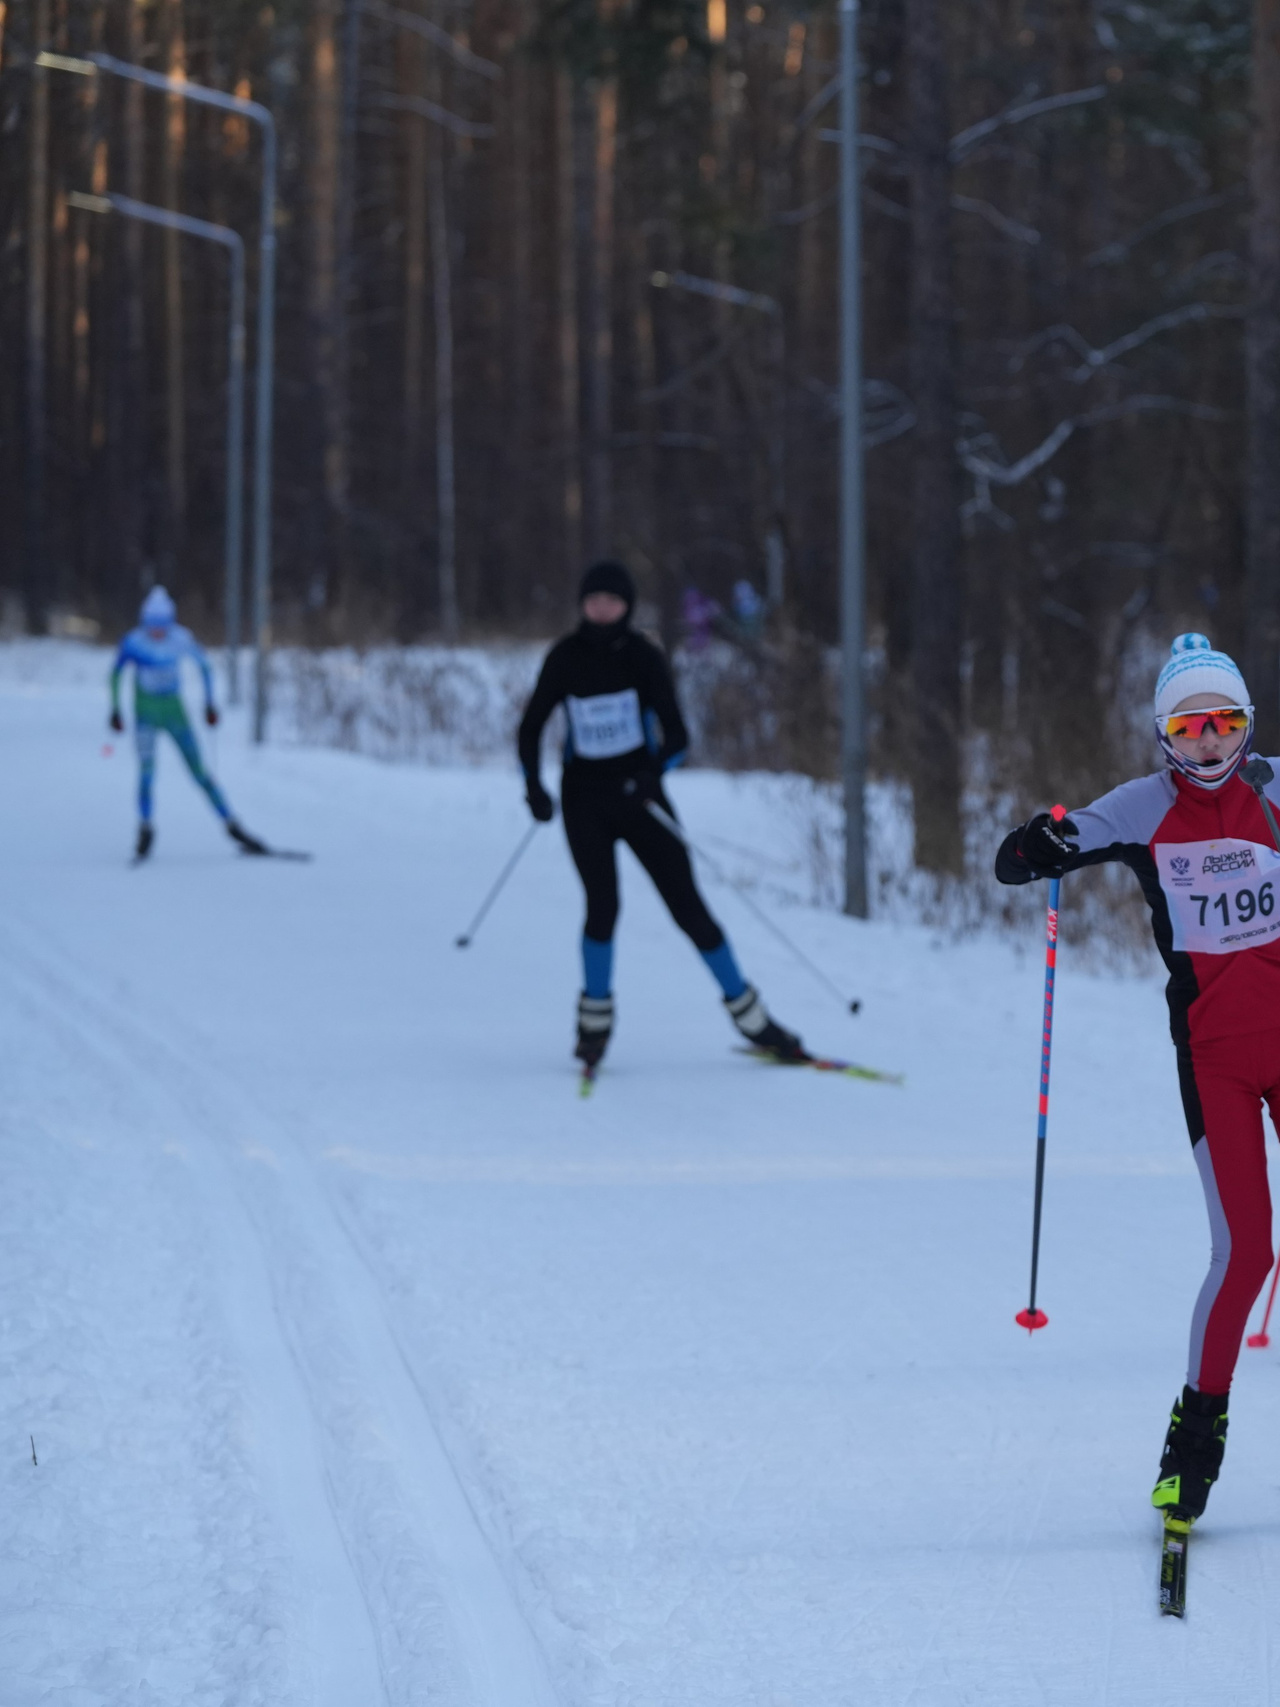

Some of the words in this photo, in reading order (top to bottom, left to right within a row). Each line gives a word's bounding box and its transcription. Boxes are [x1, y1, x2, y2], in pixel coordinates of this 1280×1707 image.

[1203, 849, 1252, 865] ЛЫЖНЯ
[1202, 858, 1256, 874] РОССИИ
[1190, 881, 1275, 927] 7196
